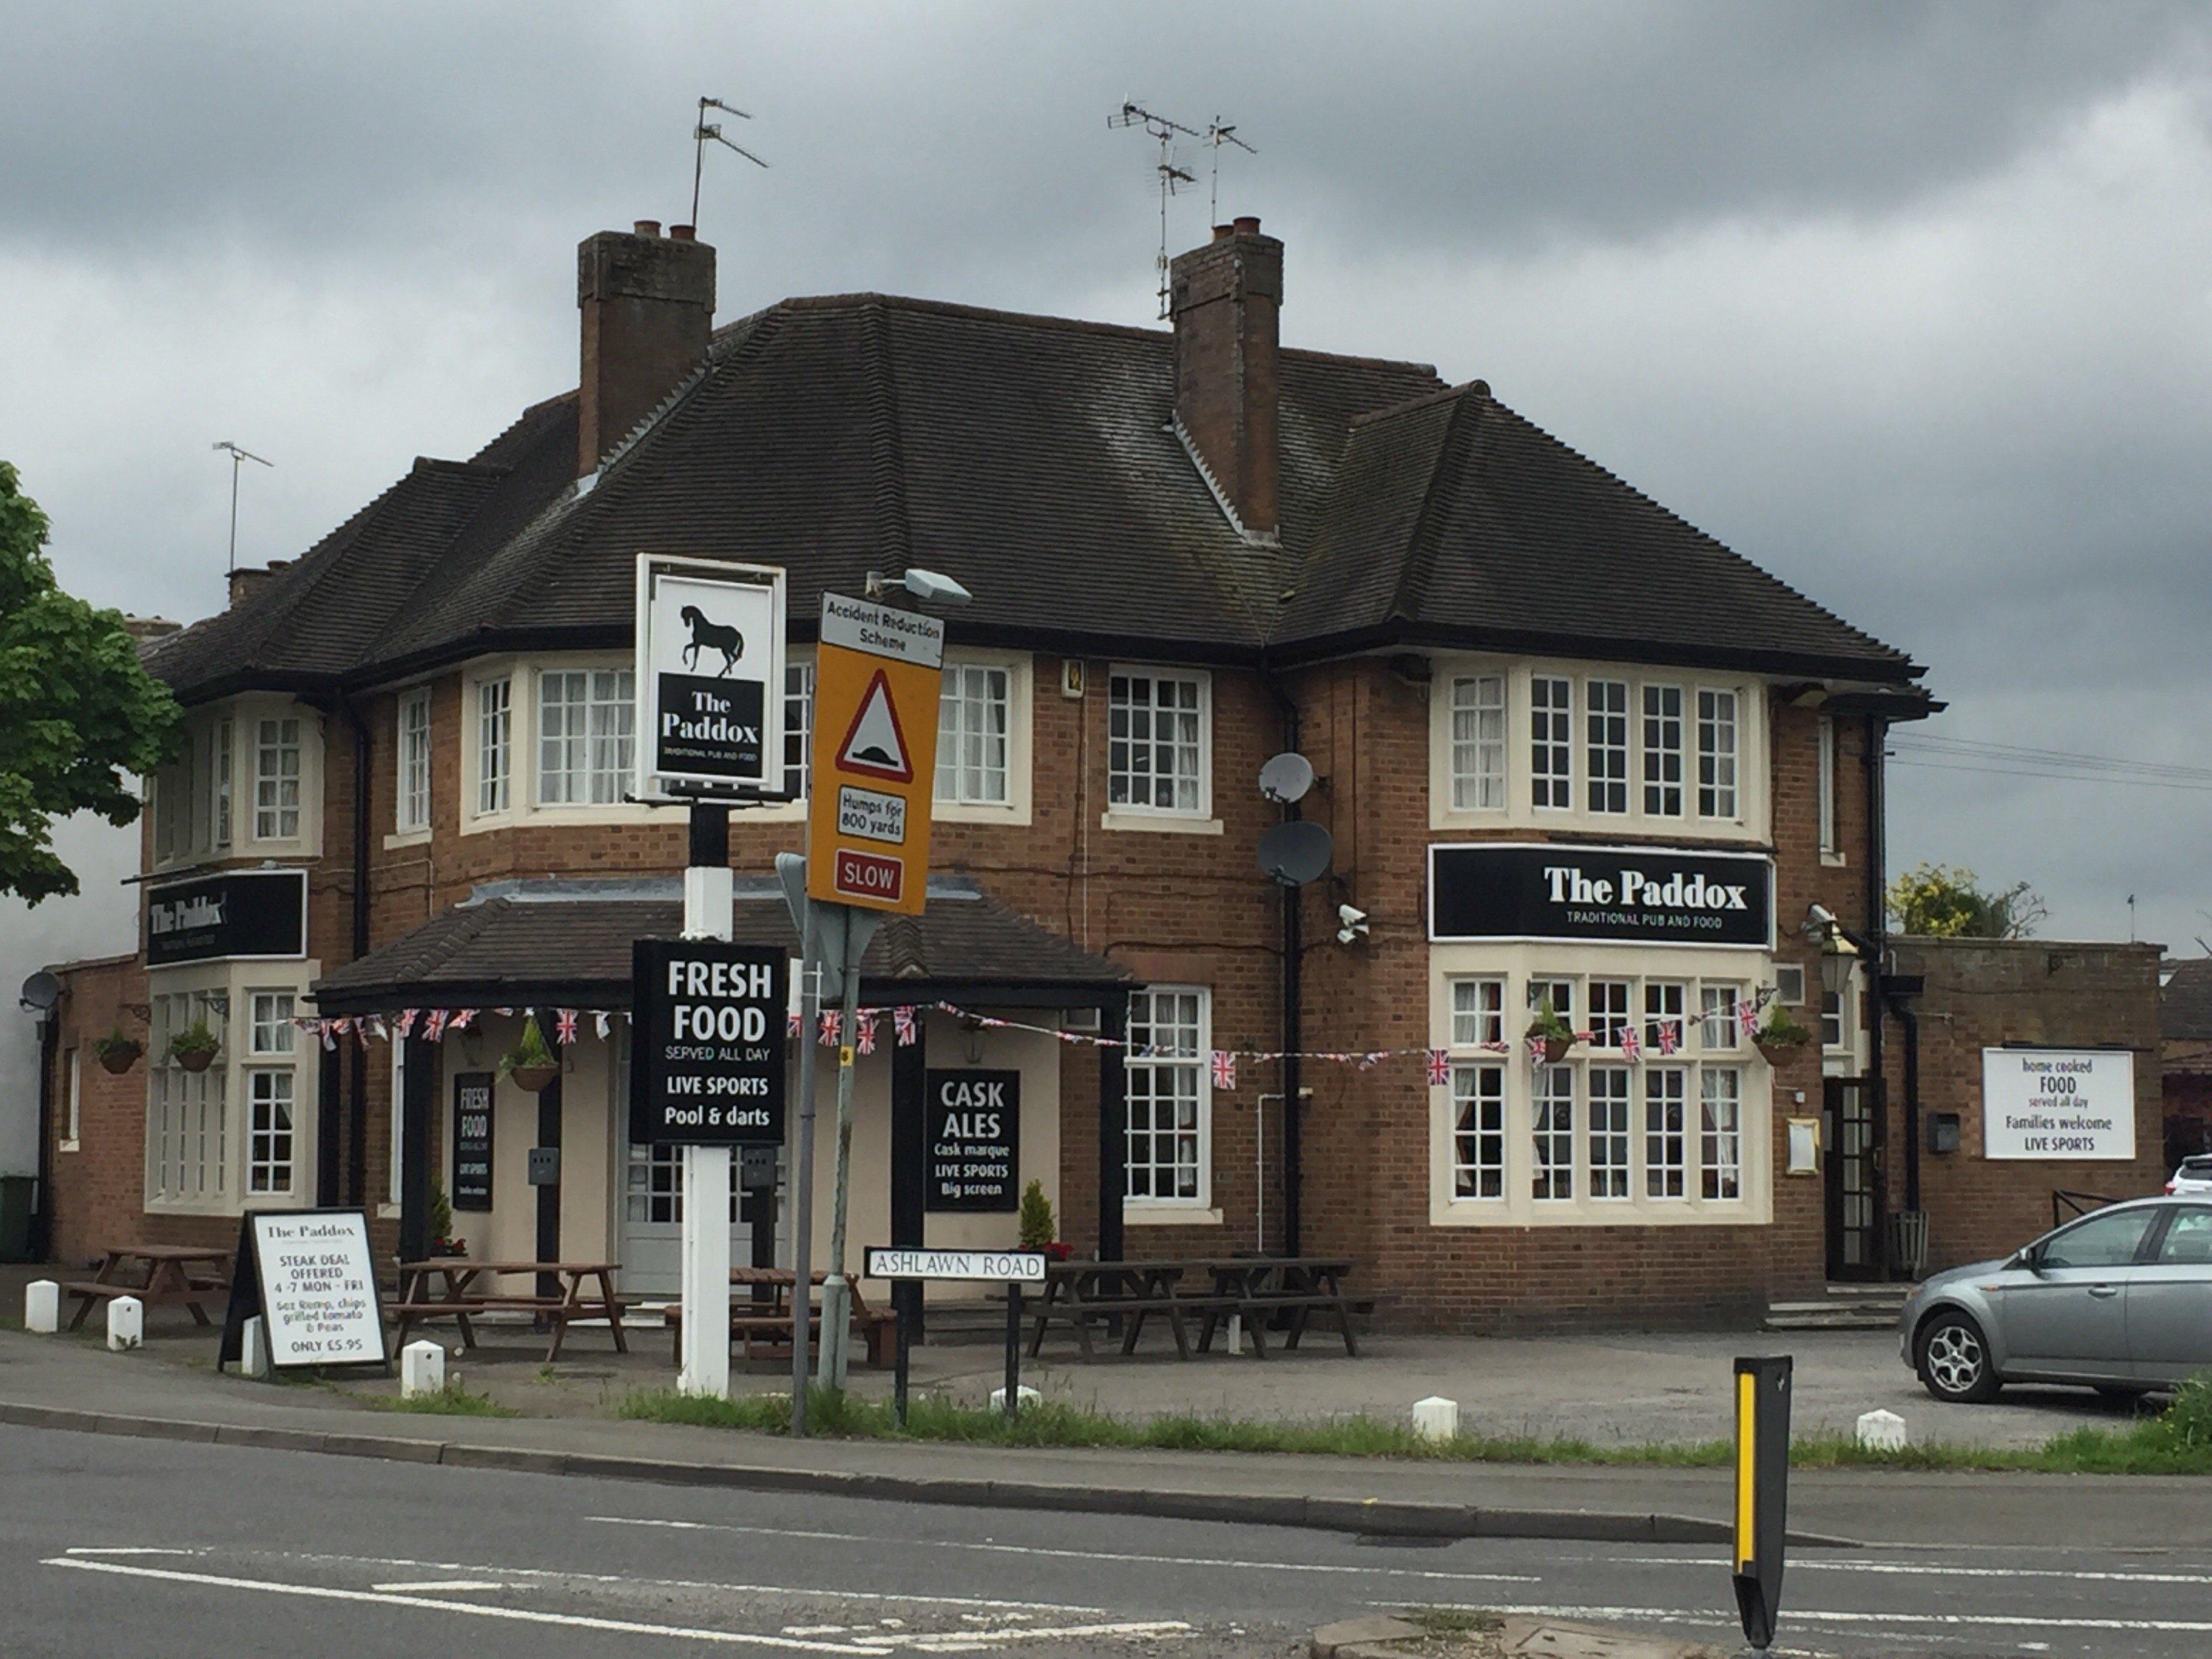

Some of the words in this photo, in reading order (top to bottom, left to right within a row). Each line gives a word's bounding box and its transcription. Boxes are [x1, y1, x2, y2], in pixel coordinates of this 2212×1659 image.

[827, 601, 879, 626] Accident
[882, 613, 940, 638] Reduction
[859, 628, 905, 651] Scheme
[691, 691, 731, 713] The
[662, 712, 758, 744] Paddox
[843, 794, 881, 814] Humps
[886, 800, 903, 817] for
[842, 813, 867, 829] 800
[870, 820, 901, 836] yards
[844, 861, 895, 889] SLOW
[1544, 867, 1613, 905] The
[1620, 870, 1748, 910] Paddox
[1567, 911, 1639, 926] TRADITIONAL
[1641, 914, 1665, 927] PUB
[1667, 916, 1690, 928] AND
[1694, 916, 1723, 929] FOOD
[668, 960, 772, 998] FRESH
[674, 1004, 766, 1042] FOOD
[665, 1045, 714, 1061] SERVED
[718, 1047, 741, 1061] ALL
[745, 1048, 771, 1061] DAY
[2022, 1057, 2052, 1073] home
[2055, 1059, 2093, 1073] cooked
[667, 1076, 703, 1094] LIVE
[706, 1076, 769, 1096] SPORTS
[941, 1081, 1004, 1107] CASK
[2040, 1076, 2076, 1094] FOOD
[2028, 1096, 2057, 1107] served
[2060, 1095, 2070, 1107] all
[2072, 1095, 2089, 1109] day
[664, 1104, 703, 1125] Pool
[708, 1107, 722, 1126] &
[726, 1105, 771, 1126] darts
[2006, 1114, 2055, 1130] Families
[2059, 1115, 2112, 1130] welcome
[462, 1115, 487, 1138] FOOD
[942, 1113, 1002, 1139] ALES
[934, 1142, 961, 1156] Cask
[964, 1145, 1010, 1160] marque
[2025, 1137, 2048, 1151] LIVE
[2051, 1137, 2095, 1151] SPORTS
[935, 1164, 960, 1178] LIVE
[963, 1164, 1008, 1179] SPORTS
[941, 1182, 961, 1199] Big
[964, 1185, 1002, 1195] screen
[268, 1226, 294, 1238] The
[300, 1225, 355, 1237] Paddox
[279, 1255, 316, 1267] STEAK
[321, 1254, 350, 1265] DEAL
[876, 1252, 970, 1274] ASHLAWN
[983, 1256, 1040, 1276] ROAD
[291, 1268, 343, 1279] OFFERED
[274, 1282, 282, 1293] 4
[302, 1282, 331, 1292] MON
[344, 1279, 364, 1290] FRI
[337, 1297, 367, 1309] chips
[283, 1311, 319, 1326] grilled
[323, 1310, 363, 1319] tomato
[317, 1323, 344, 1332] Peas
[291, 1340, 323, 1353] ONLY
[327, 1338, 363, 1351] £5.95
